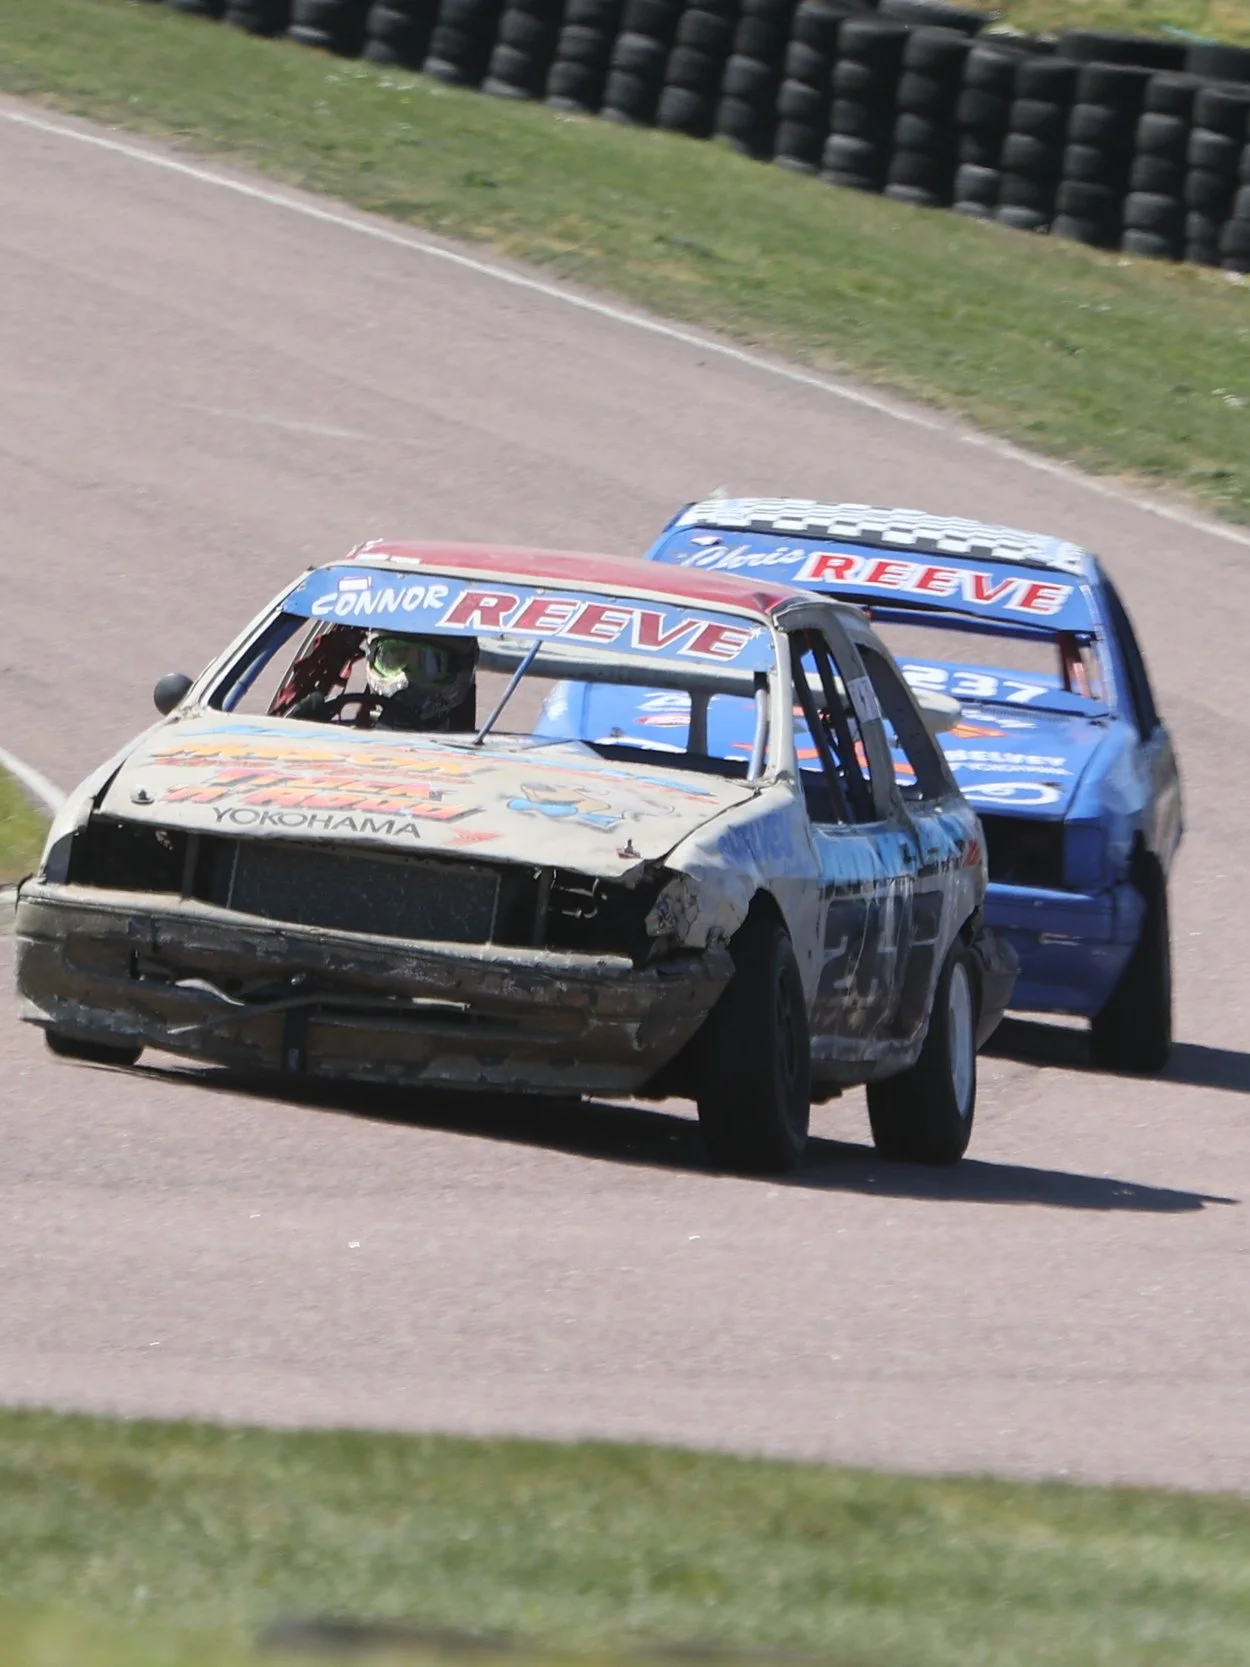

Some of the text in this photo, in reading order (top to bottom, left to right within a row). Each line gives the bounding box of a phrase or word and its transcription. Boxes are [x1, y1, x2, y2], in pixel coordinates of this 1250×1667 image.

[792, 551, 1073, 615] REEVE
[311, 584, 755, 662] CONNOR REEVE
[902, 664, 1050, 702] 237
[211, 806, 422, 839] YOKOHAMA
